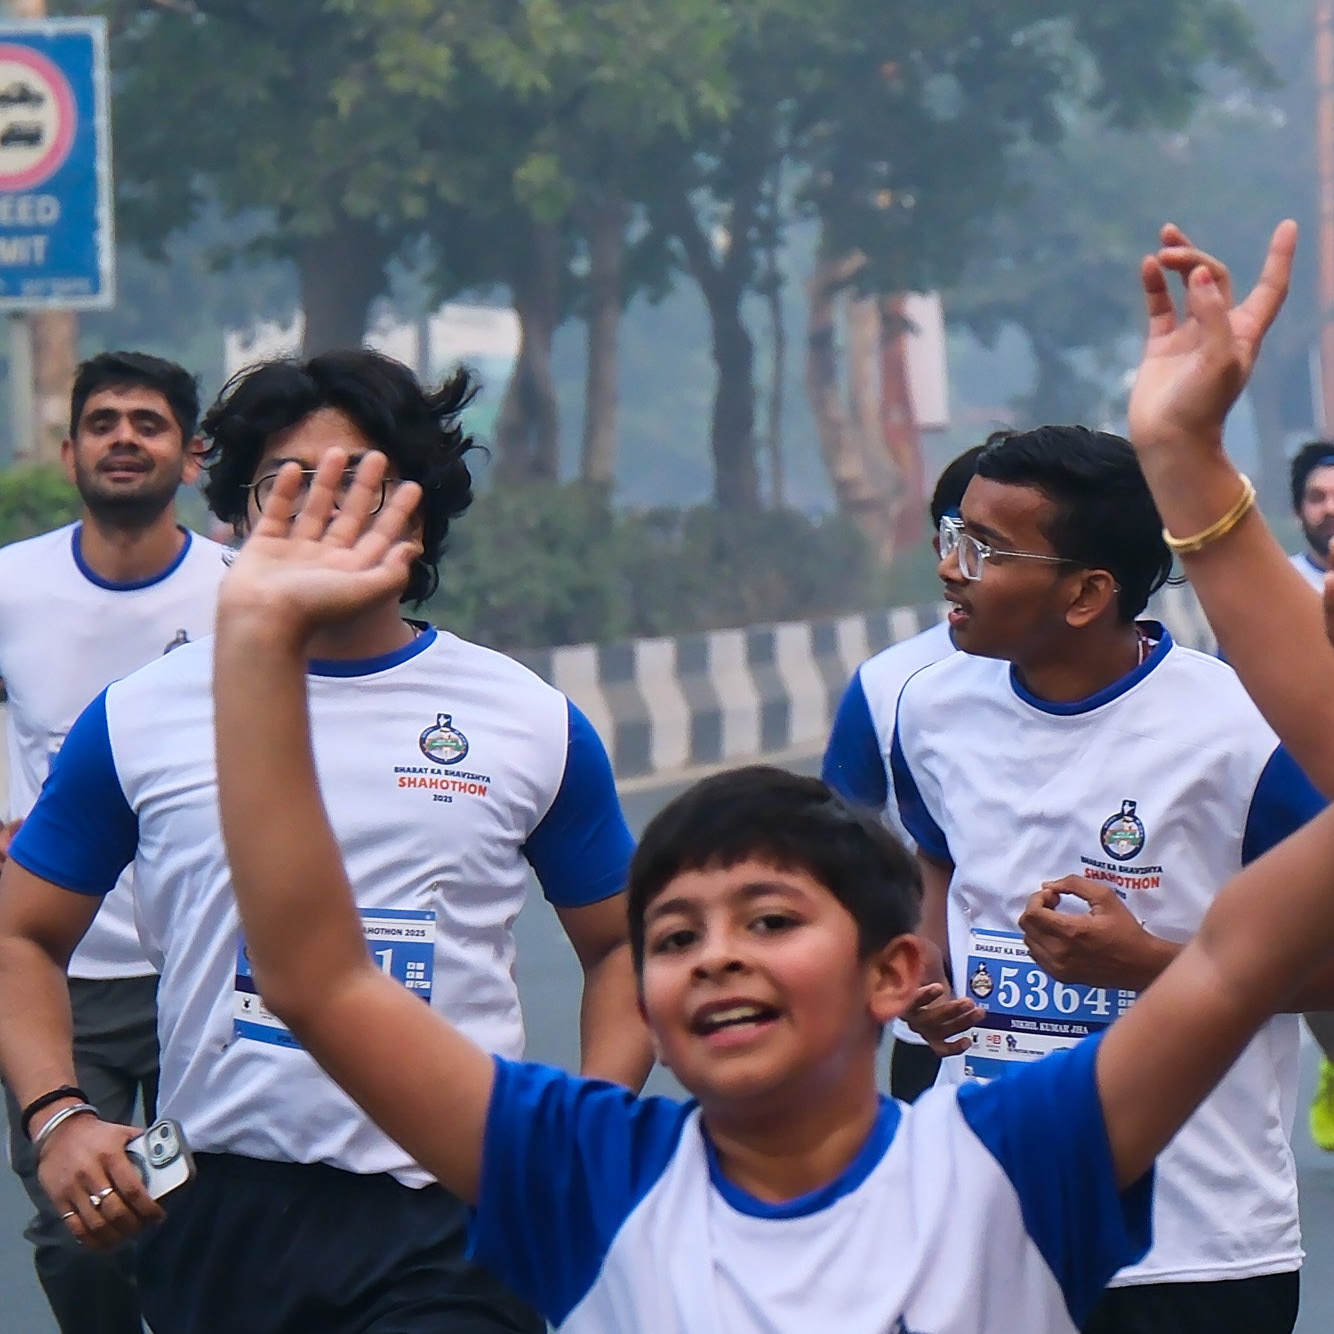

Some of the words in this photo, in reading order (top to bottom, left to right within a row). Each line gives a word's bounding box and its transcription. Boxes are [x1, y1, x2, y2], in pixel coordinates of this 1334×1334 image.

[394, 766, 429, 774] BHARAT
[430, 768, 442, 776] KA
[444, 769, 491, 783] BHAVISHYA
[398, 776, 487, 797] SHAHOTHON
[432, 794, 453, 803] 2025
[404, 929, 426, 937] 2025
[998, 966, 1111, 1016] 5364
